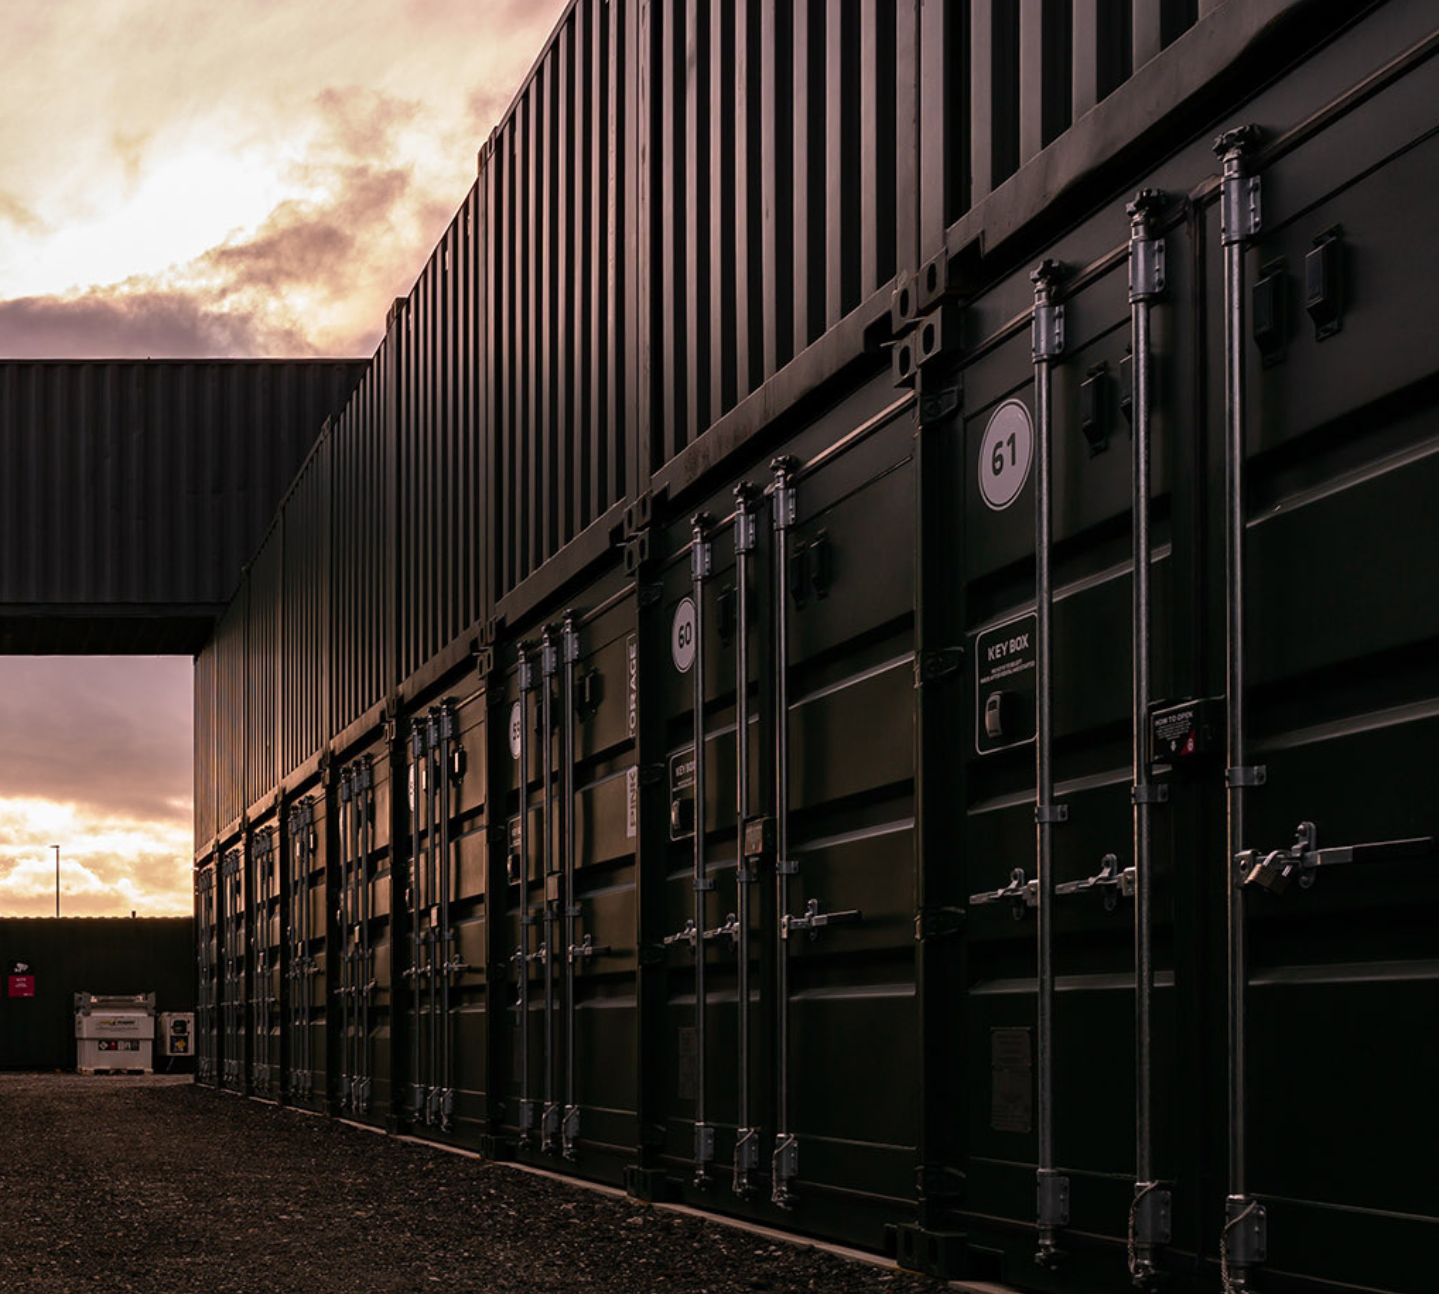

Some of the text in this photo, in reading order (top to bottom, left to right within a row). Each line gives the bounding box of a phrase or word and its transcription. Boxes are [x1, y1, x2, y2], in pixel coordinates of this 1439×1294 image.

[992, 432, 1016, 476] 61
[678, 621, 692, 649] 60
[987, 632, 1030, 661] KEY BOX
